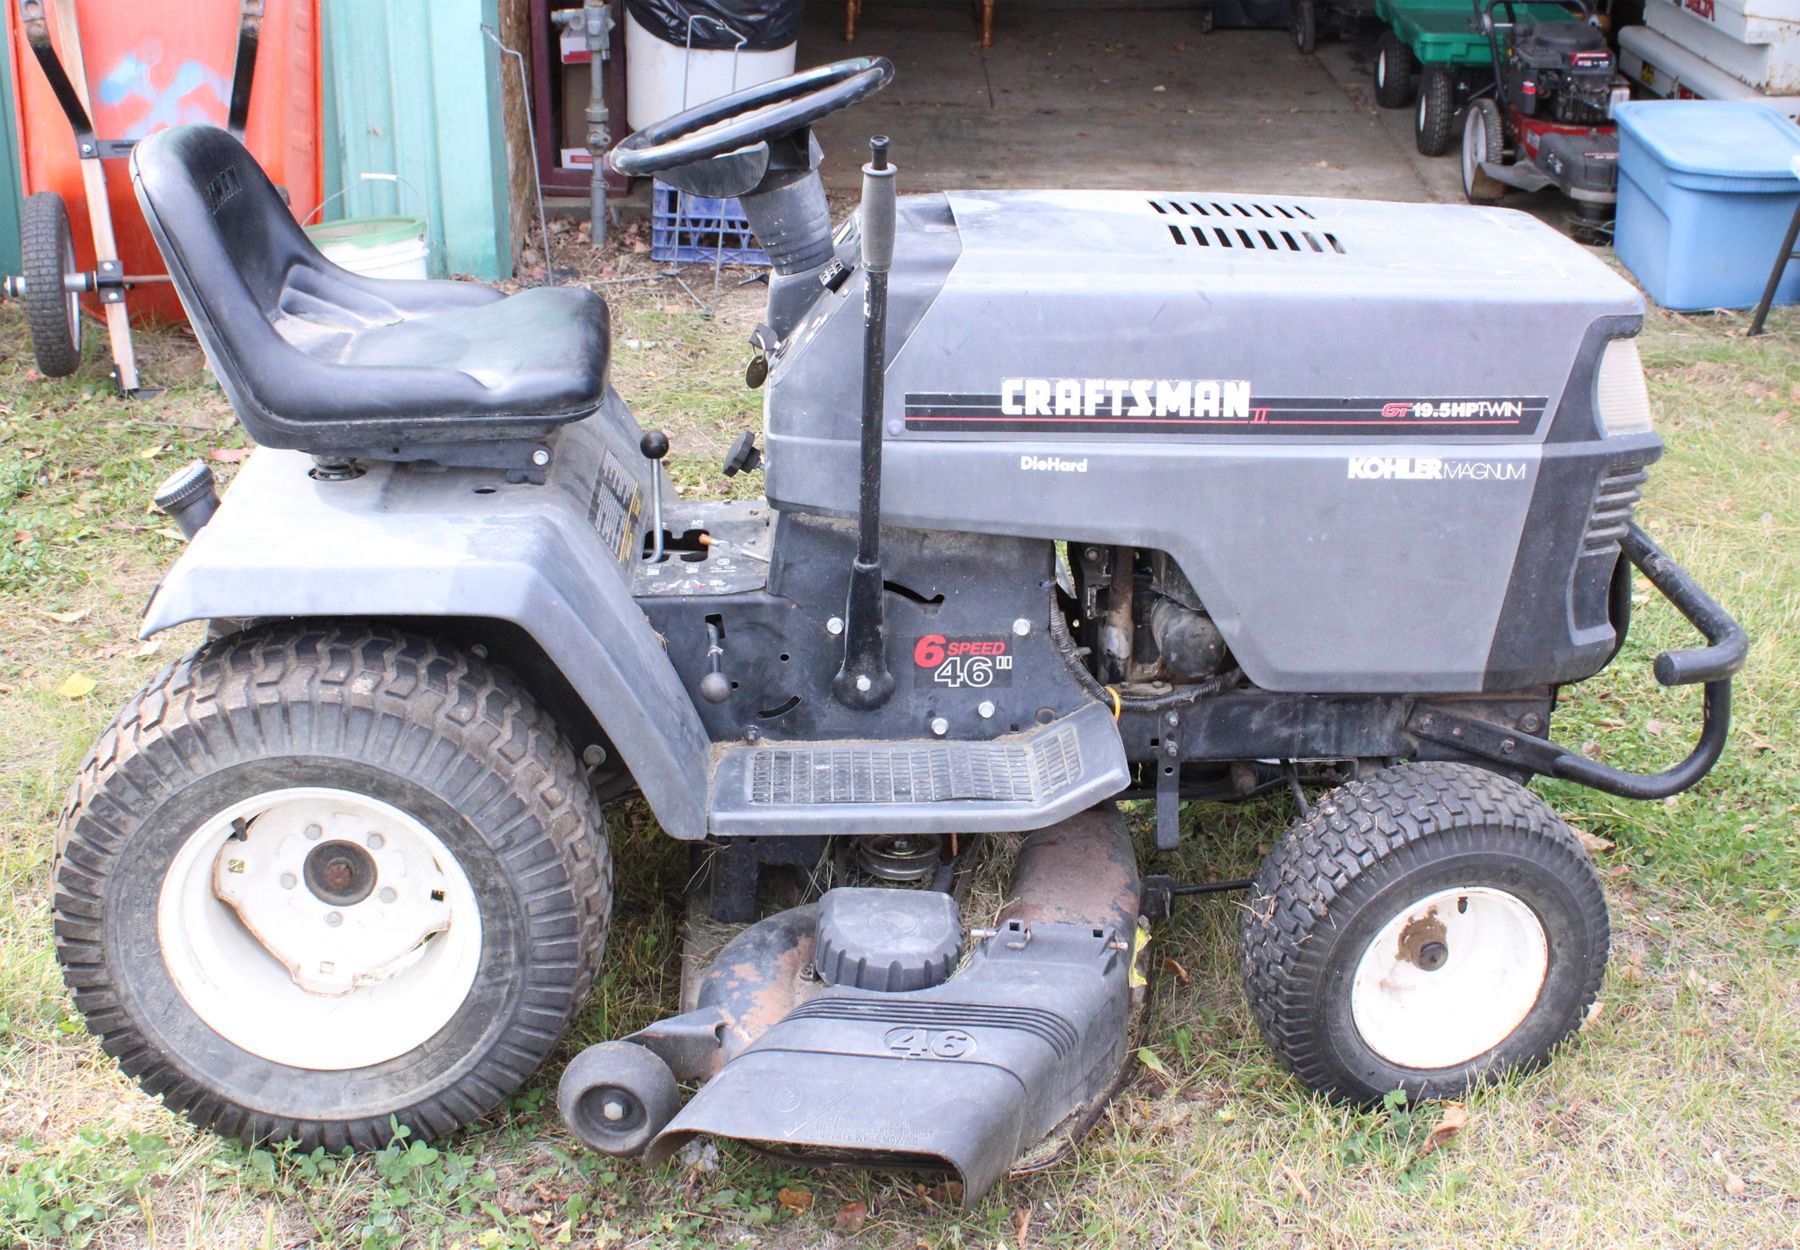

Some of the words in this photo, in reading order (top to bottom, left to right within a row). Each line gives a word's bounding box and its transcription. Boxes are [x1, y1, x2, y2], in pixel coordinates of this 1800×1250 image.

[1001, 379, 1250, 418] CRAFTSMAN
[1381, 402, 1413, 418] GT
[1020, 455, 1088, 473] DieHard
[1348, 457, 1443, 480] KOHLER
[1444, 462, 1526, 480] MAGNUM
[914, 634, 947, 668] 6
[947, 641, 1006, 656] SPEED
[889, 1027, 969, 1058] 46
